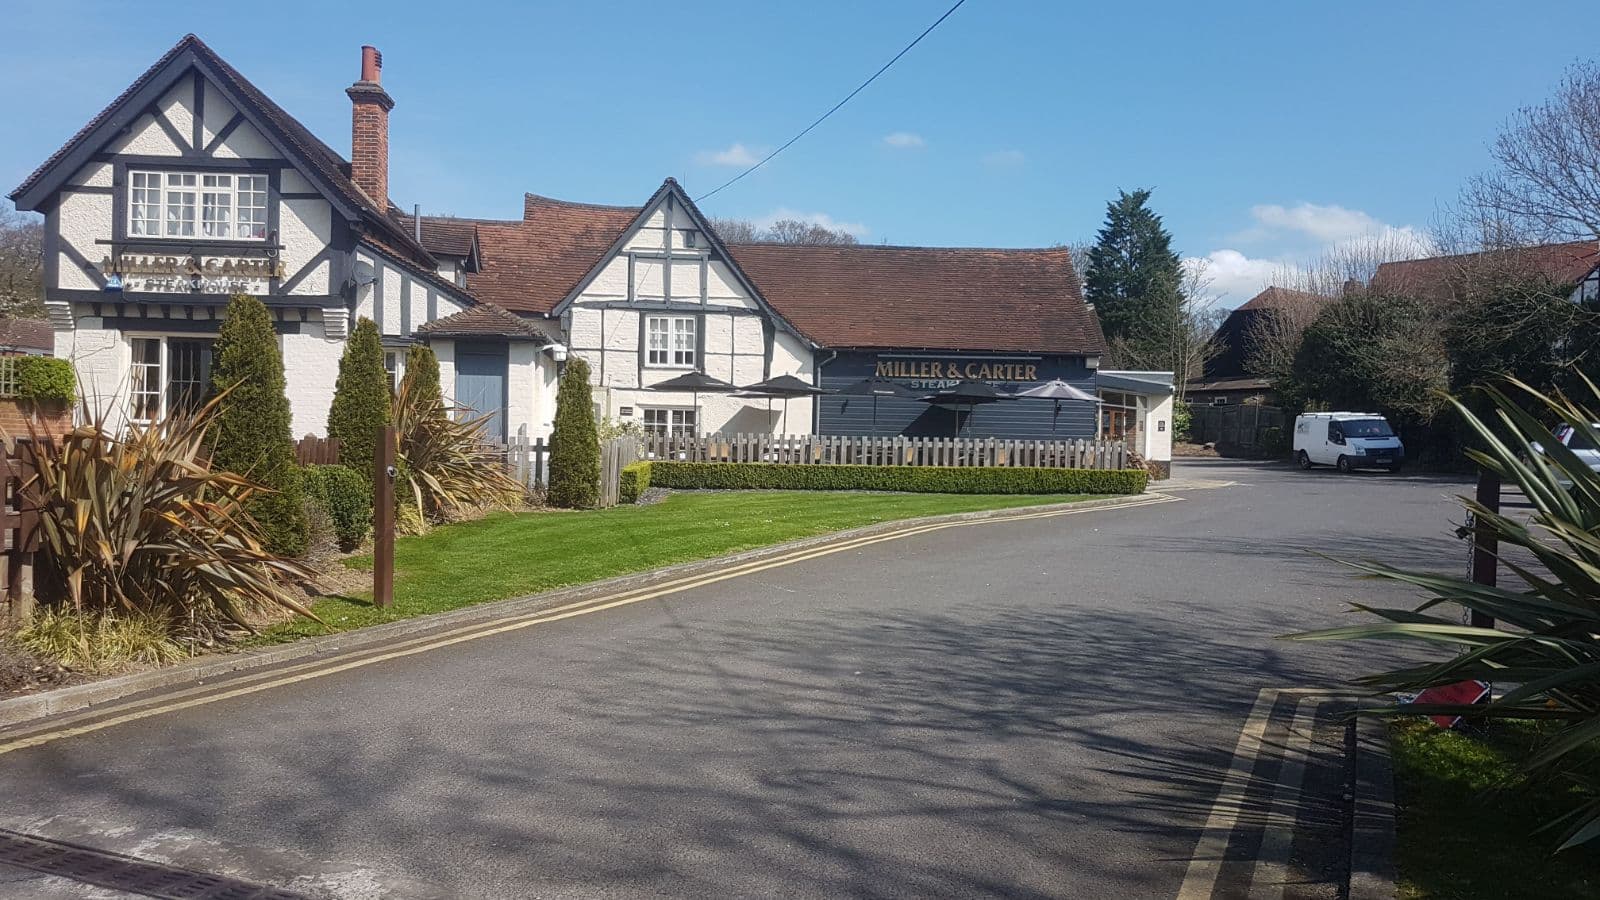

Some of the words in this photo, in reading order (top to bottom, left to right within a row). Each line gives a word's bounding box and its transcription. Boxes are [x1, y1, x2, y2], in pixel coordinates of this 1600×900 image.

[102, 255, 178, 275] MILLER
[185, 256, 201, 275] &
[205, 257, 287, 277] CARTER
[876, 361, 943, 378] MILLER
[946, 362, 964, 379] &
[965, 363, 1038, 380] CARTER
